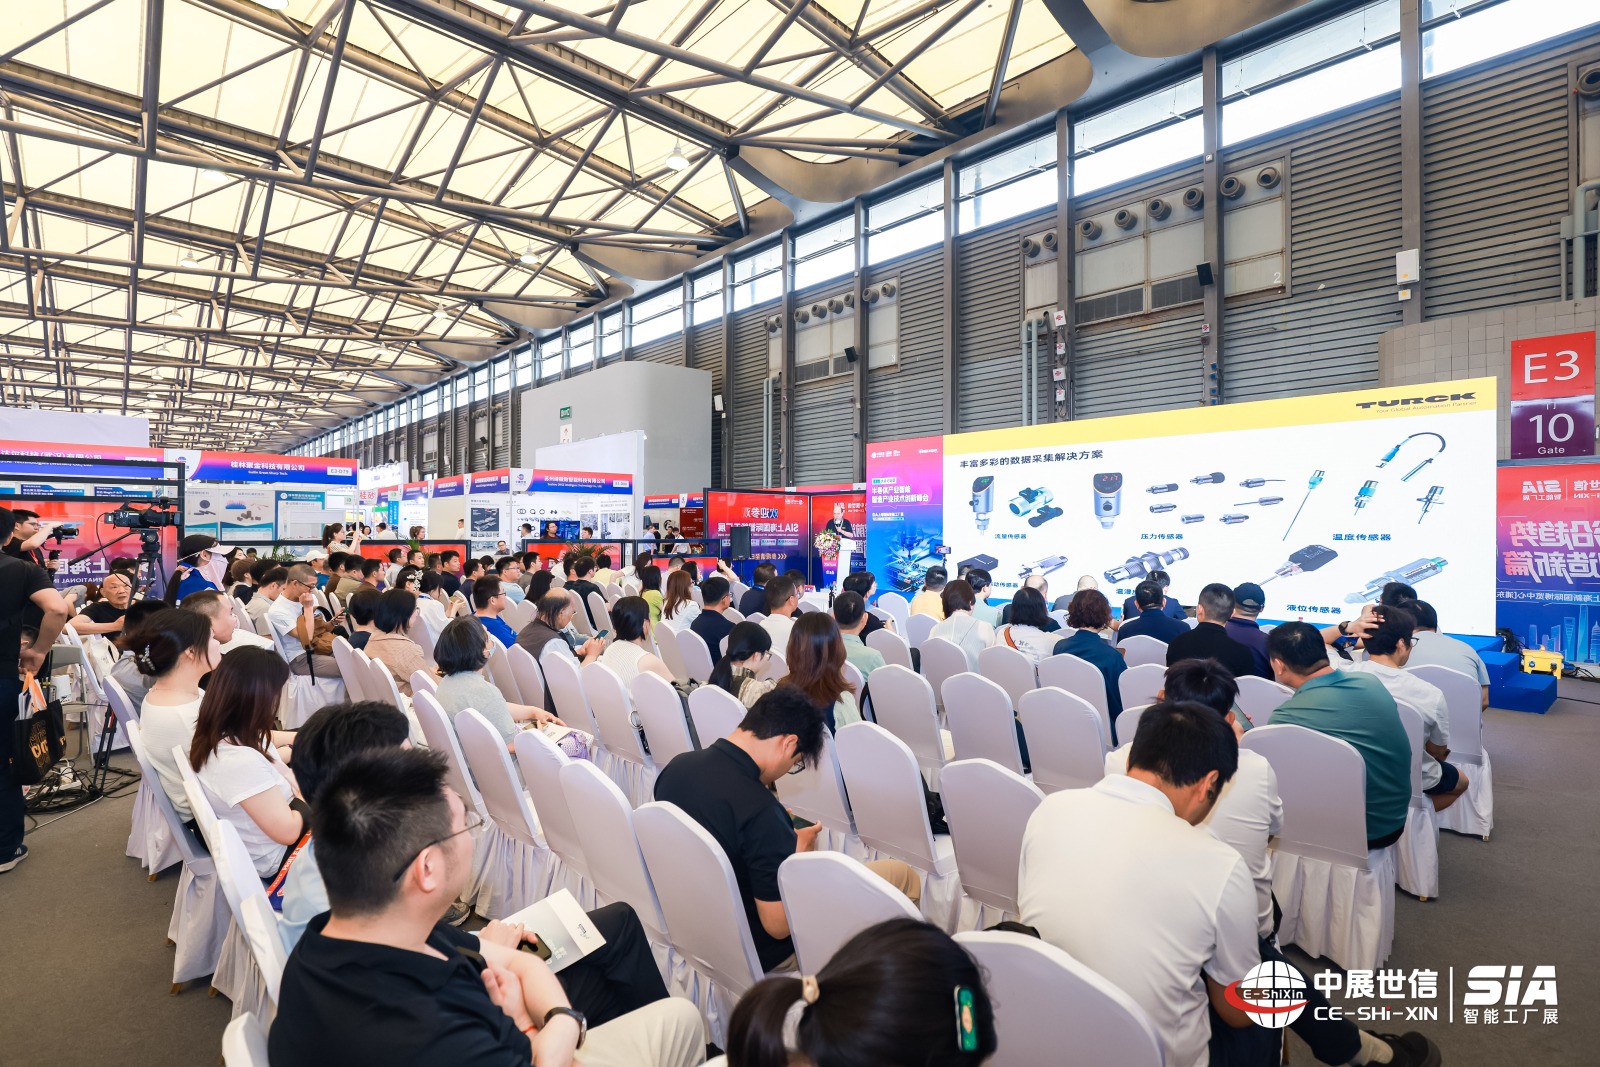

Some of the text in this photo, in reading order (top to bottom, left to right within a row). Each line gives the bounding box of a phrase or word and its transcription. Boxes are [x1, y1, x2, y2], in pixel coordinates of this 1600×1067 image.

[1273, 271, 1281, 283] 2
[1524, 349, 1580, 385] E3
[1356, 392, 1476, 409] TURCK
[1412, 403, 1451, 411] Automation
[1529, 412, 1575, 444] 10
[1537, 446, 1565, 455] Gate
[960, 449, 1103, 469] 丰富多彩的数据采集解决方案
[1332, 533, 1392, 542] 温度传感器
[1286, 604, 1341, 615] 液位传感器
